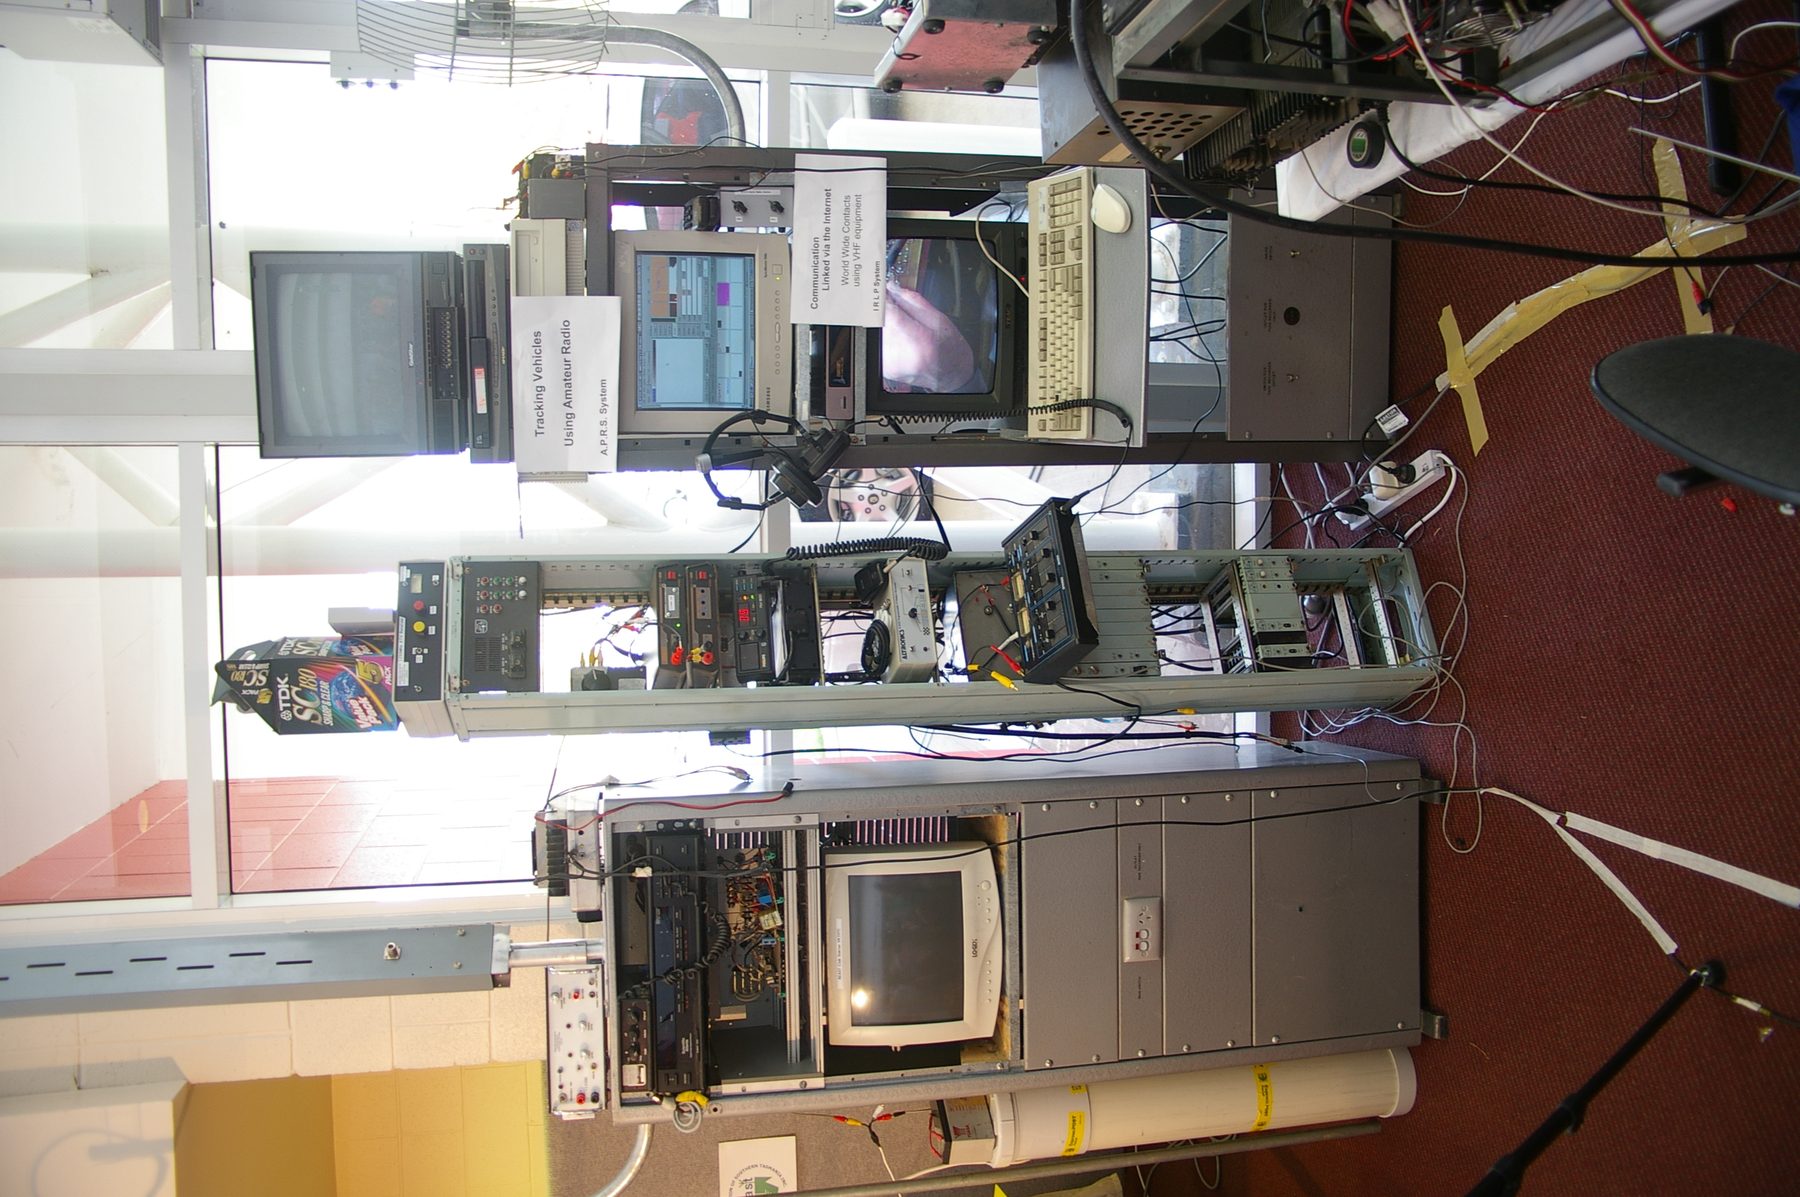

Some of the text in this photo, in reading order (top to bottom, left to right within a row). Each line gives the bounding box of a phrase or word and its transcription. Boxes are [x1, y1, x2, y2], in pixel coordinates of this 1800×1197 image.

[822, 188, 832, 291] Linked via the Internet
[841, 195, 851, 286] World Wide Contacts
[853, 194, 863, 287] using VHF equipment
[810, 237, 820, 310] Communication
[532, 330, 546, 437] Tracking Vehicles
[560, 320, 576, 446] Using Amateur Radio
[599, 379, 609, 456] A.P.R.S. System
[280, 638, 297, 651] TDK
[899, 630, 907, 660] ALTRONICS
[356, 658, 384, 684] 5
[384, 665, 392, 686] PACK
[276, 676, 290, 710] TDK
[320, 681, 331, 701] CLEAR
[322, 705, 334, 726] SHARP
[349, 698, 372, 728] Value
[358, 696, 382, 724] Pack
